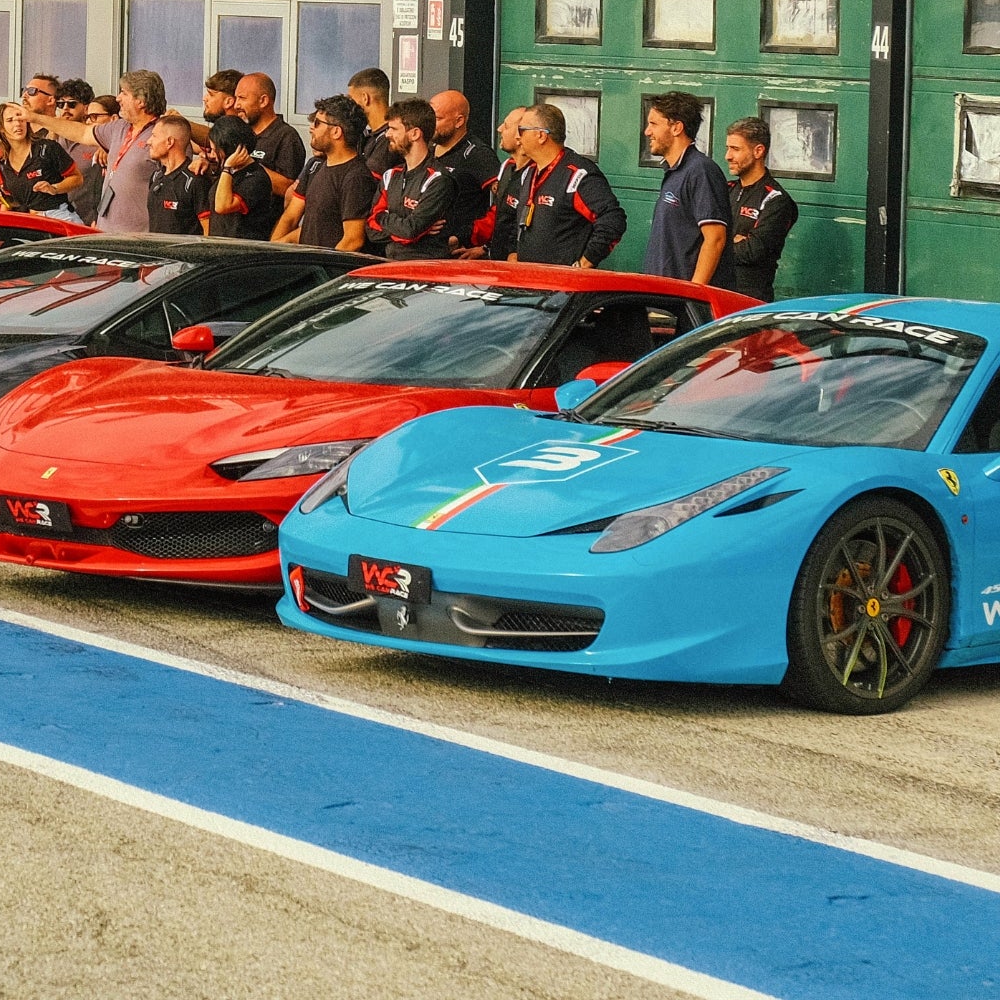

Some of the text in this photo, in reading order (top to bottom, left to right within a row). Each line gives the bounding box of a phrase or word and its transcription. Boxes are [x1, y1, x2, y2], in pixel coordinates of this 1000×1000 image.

[449, 18, 464, 48] 45
[871, 26, 889, 59] 44
[40, 252, 80, 262] CAN
[78, 256, 138, 268] RACE
[338, 282, 504, 301] WE CAN RACE
[773, 312, 850, 322] CAN
[850, 316, 959, 345] RACE
